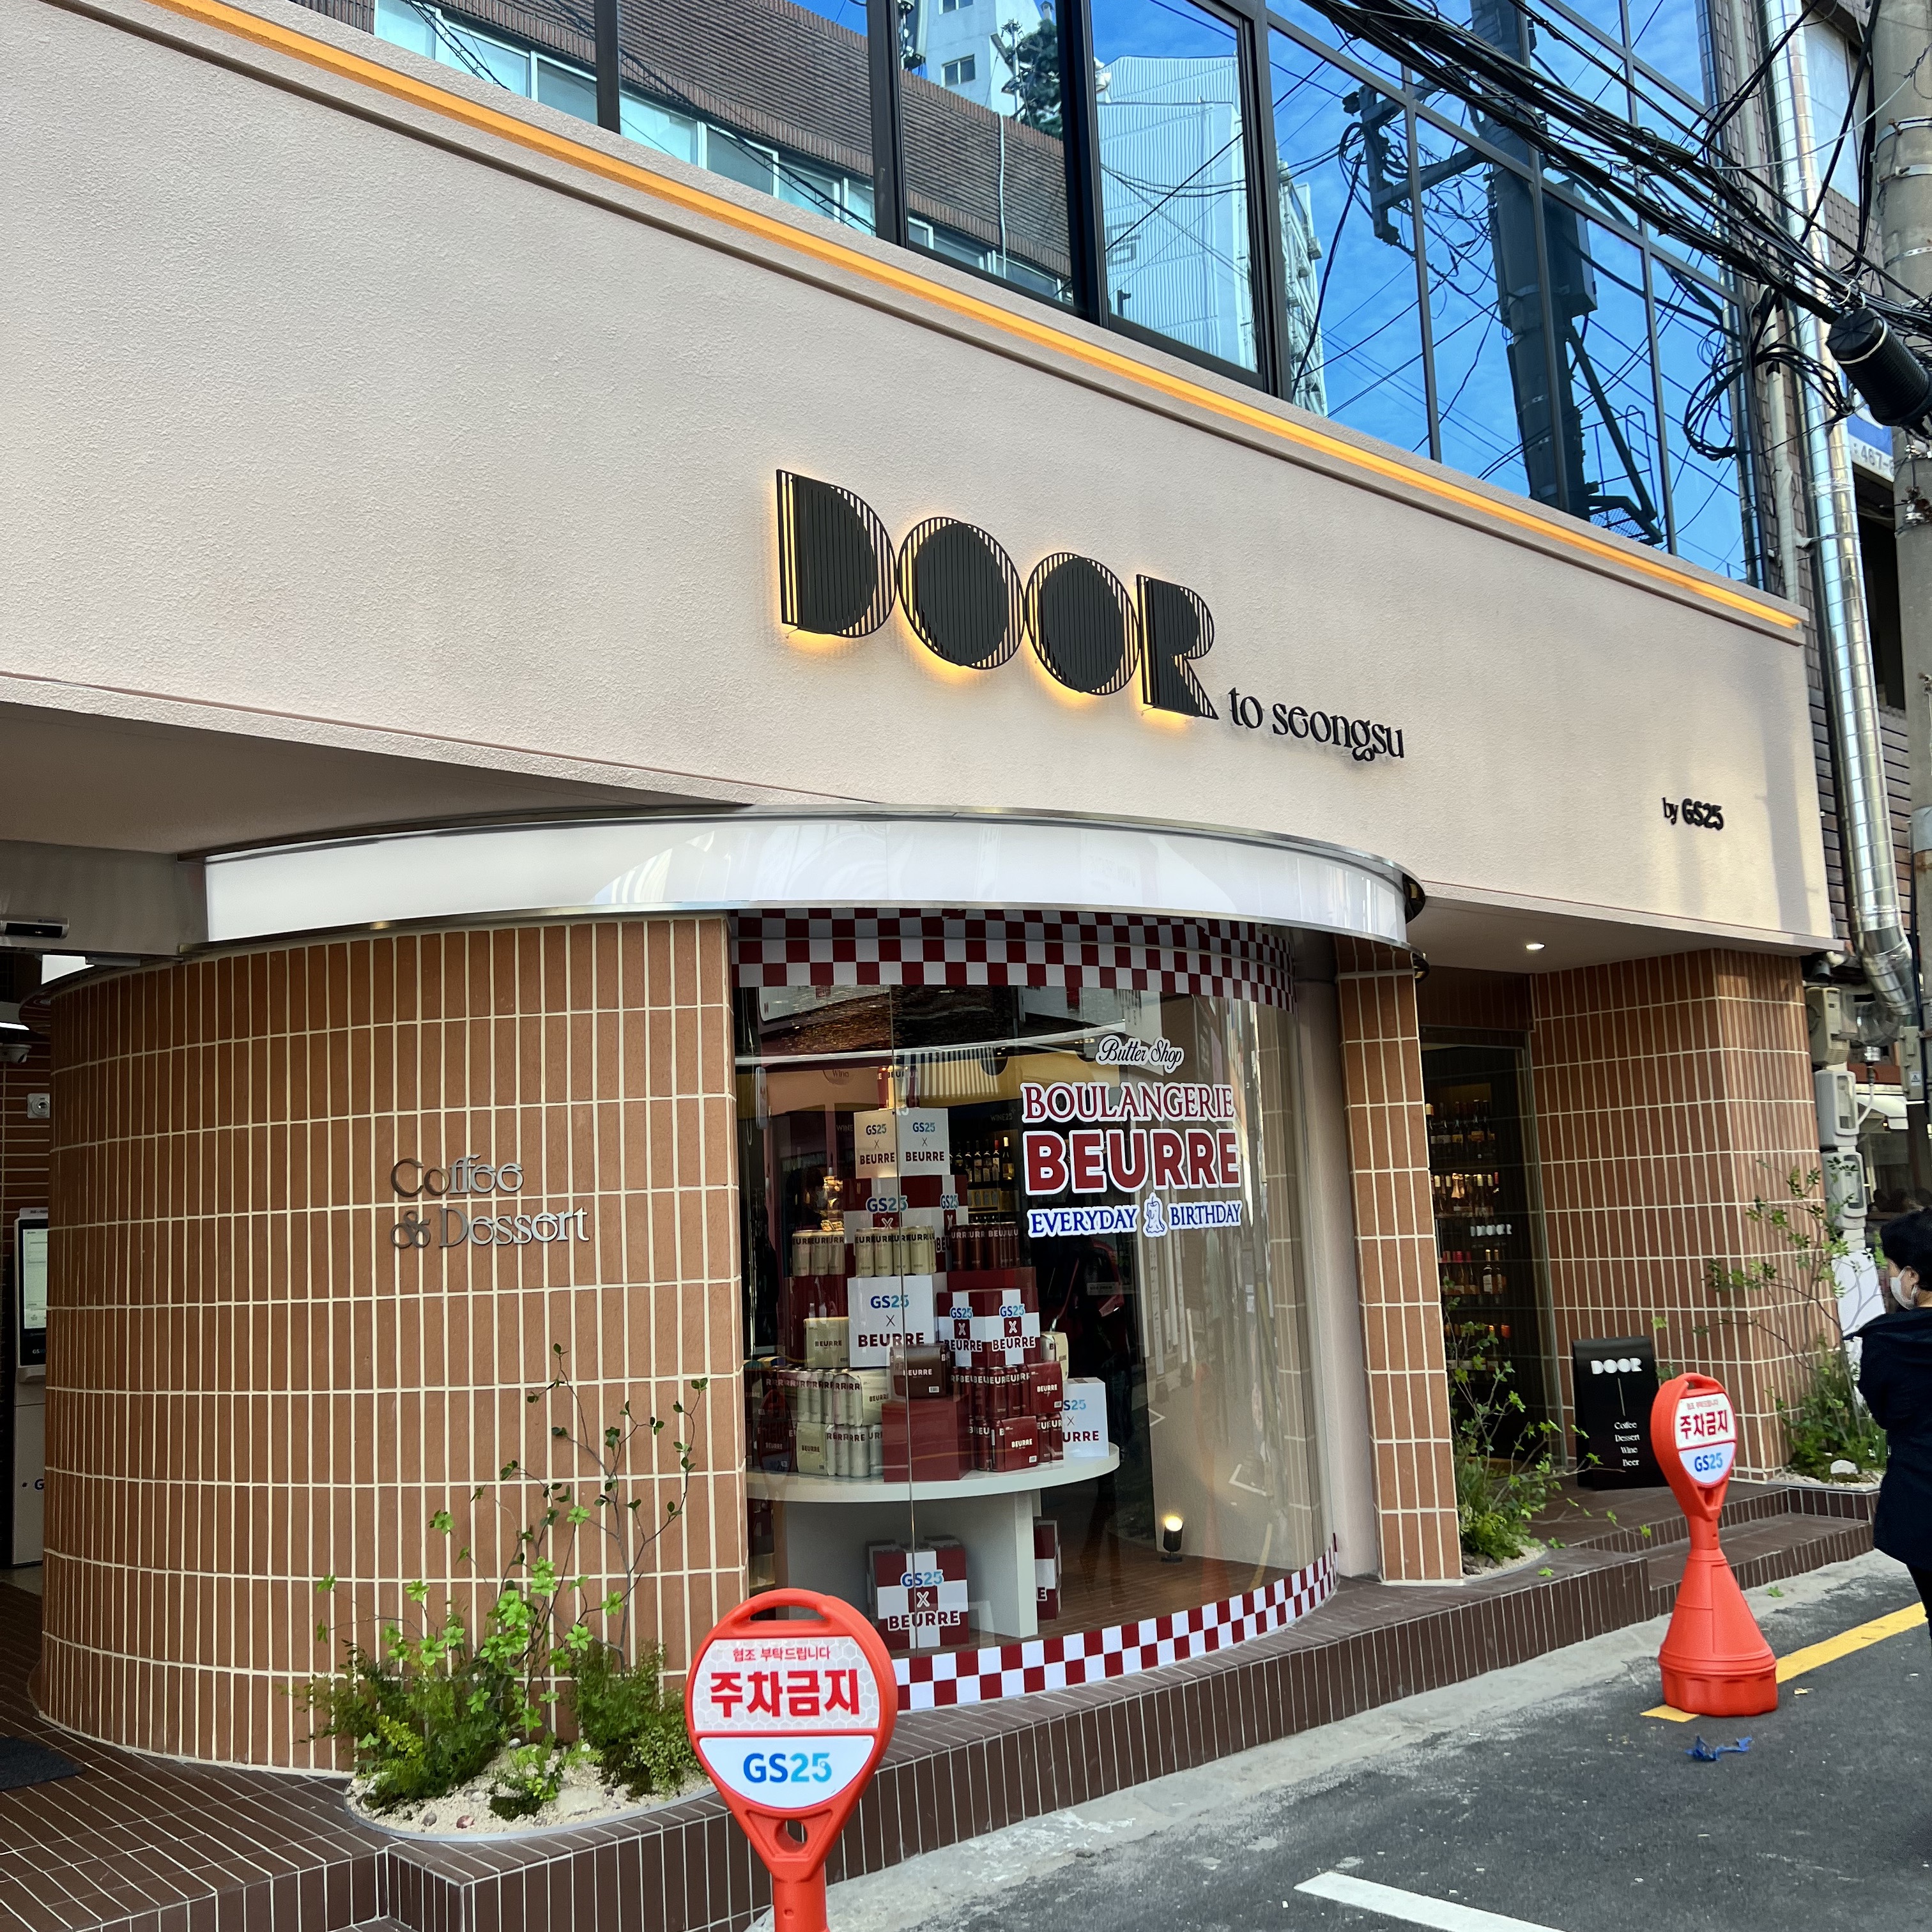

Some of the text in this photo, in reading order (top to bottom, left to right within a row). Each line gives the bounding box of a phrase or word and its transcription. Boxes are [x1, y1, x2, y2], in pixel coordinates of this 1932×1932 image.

[777, 469, 1218, 719] DOOR
[1228, 687, 1404, 761] to seongsu
[1662, 797, 1724, 831] by GS25
[1098, 1038, 1182, 1070] Butter Shop
[1023, 1085, 1234, 1119] BOULANGERIE
[866, 1124, 887, 1135] GS25
[912, 1122, 936, 1132] GS25
[860, 1152, 894, 1165] BEURRE
[905, 1151, 945, 1162] BEURRE
[1025, 1131, 1240, 1192] BEURRE
[390, 1154, 524, 1197] Coffee
[941, 1195, 958, 1209] GS25
[1030, 1203, 1241, 1234] EVERYDAY BIRTHDAY
[390, 1206, 590, 1249] & Dessert
[870, 1294, 910, 1308] GS25
[950, 1307, 973, 1319] GS25
[1000, 1305, 1025, 1317] GS25
[858, 1332, 924, 1347] BEURRE
[993, 1336, 1035, 1351] BEURRE
[1590, 1357, 1643, 1375] DOOR
[1036, 1384, 1057, 1393] BEURRE
[869, 1393, 889, 1402] BEURRE
[1062, 1400, 1086, 1411] S25
[1680, 1409, 1728, 1439] 주차금지
[1011, 1438, 1033, 1448] BEURRE
[1062, 1430, 1099, 1443] URRE
[801, 1445, 820, 1453] BEURRE
[1694, 1452, 1723, 1472] GS25
[901, 1571, 943, 1587] GS25
[889, 1611, 959, 1630] BEURRE
[732, 1645, 831, 1662] 협조 부탁드립니다
[710, 1668, 860, 1719] 주차금지
[743, 1752, 832, 1784] GS25
